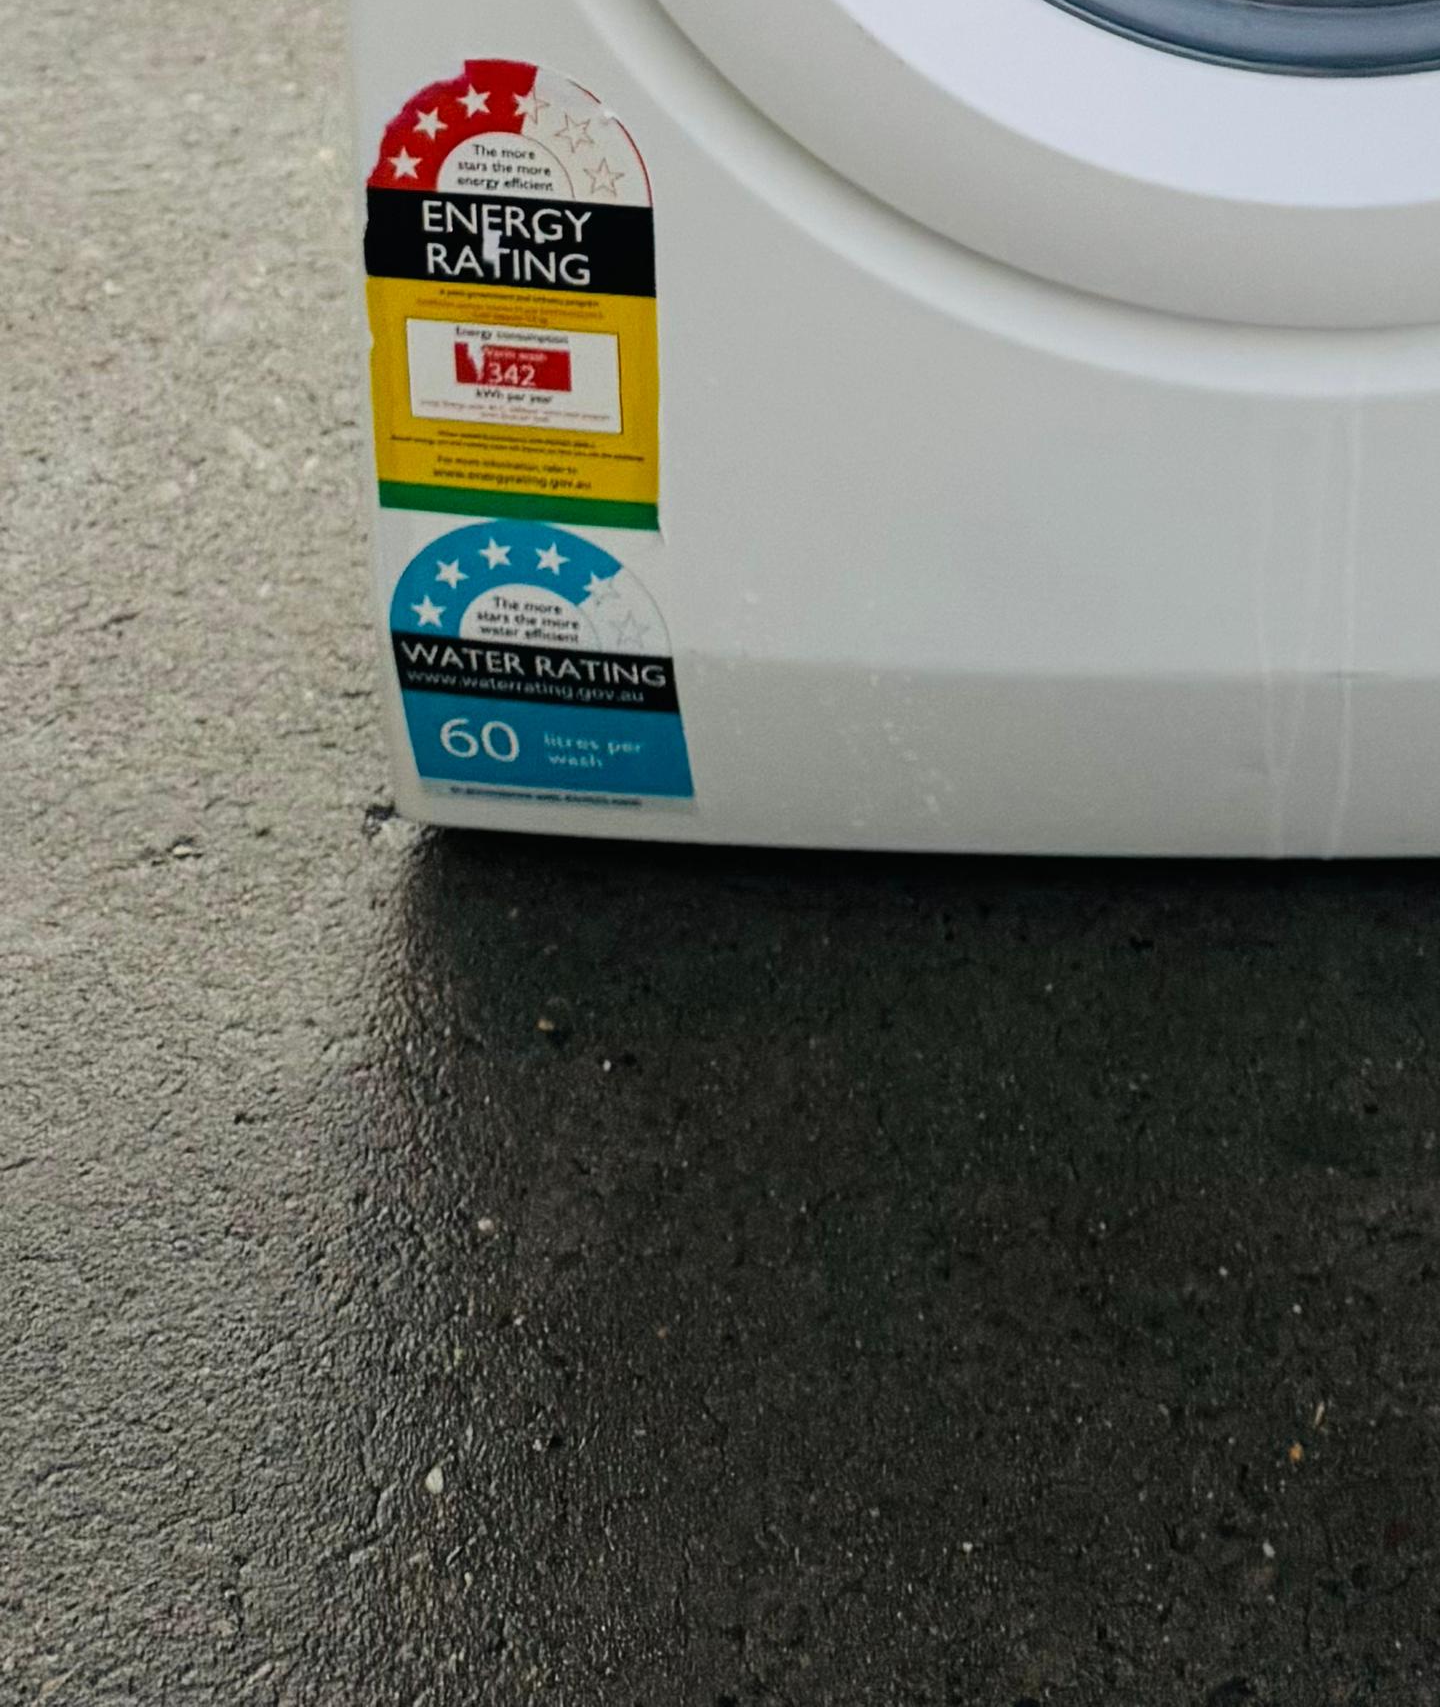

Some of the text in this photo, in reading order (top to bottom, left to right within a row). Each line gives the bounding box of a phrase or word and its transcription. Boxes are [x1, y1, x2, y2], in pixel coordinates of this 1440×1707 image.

[473, 144, 536, 160] The more
[458, 161, 552, 175] stars the more
[457, 178, 553, 191] energy efficient
[422, 200, 592, 244] ENERGY
[426, 243, 591, 286] RATING
[456, 327, 493, 340] Energy
[488, 363, 536, 387] 342
[493, 597, 562, 615] The more
[477, 613, 579, 630] stars the more
[479, 625, 579, 643] water efficient
[401, 641, 667, 686] WATER RATING
[407, 670, 644, 702] www.waterrating.gov.au
[440, 718, 520, 763] 60
